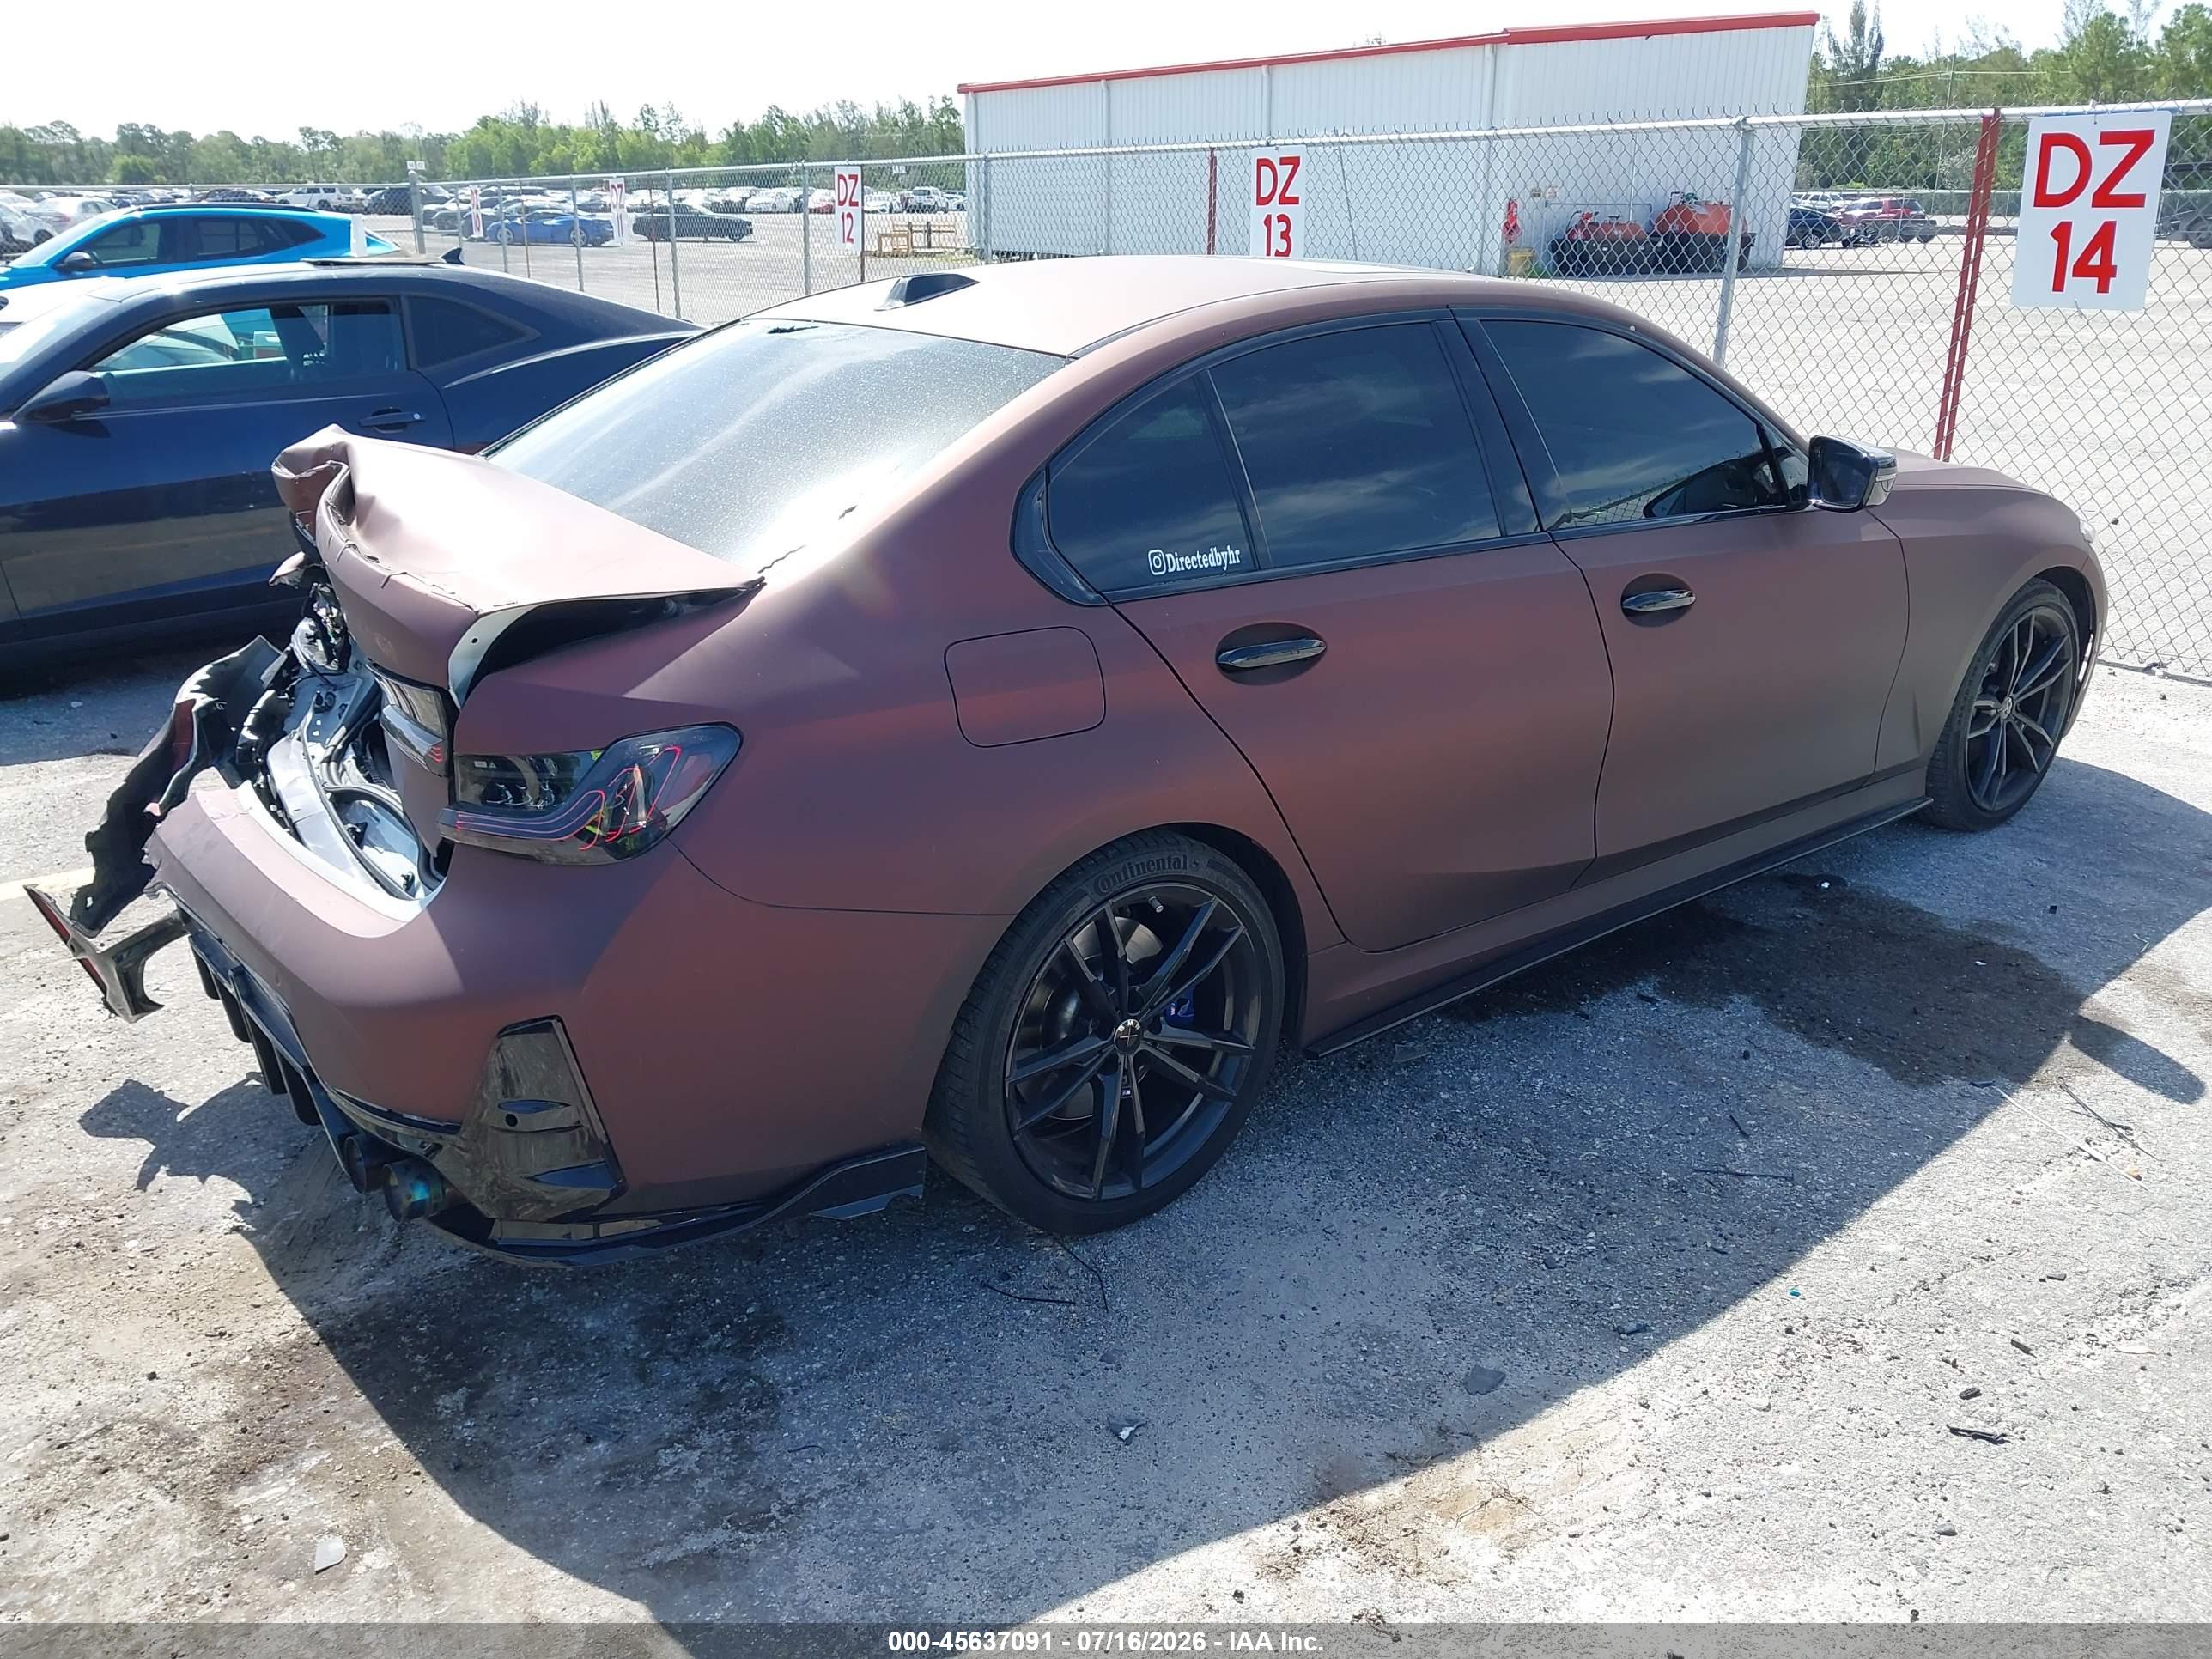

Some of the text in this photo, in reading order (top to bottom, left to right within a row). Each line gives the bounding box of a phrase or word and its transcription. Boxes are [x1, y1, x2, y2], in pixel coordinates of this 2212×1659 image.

[837, 173, 859, 207] DZ
[1255, 155, 1301, 206] DZ
[2033, 129, 2156, 208] DZ
[841, 211, 854, 244] 12
[1263, 213, 1292, 258] 13
[2049, 220, 2118, 294] 14
[1165, 544, 1242, 573] Directedbyhr
[1092, 854, 1188, 896] Continental
